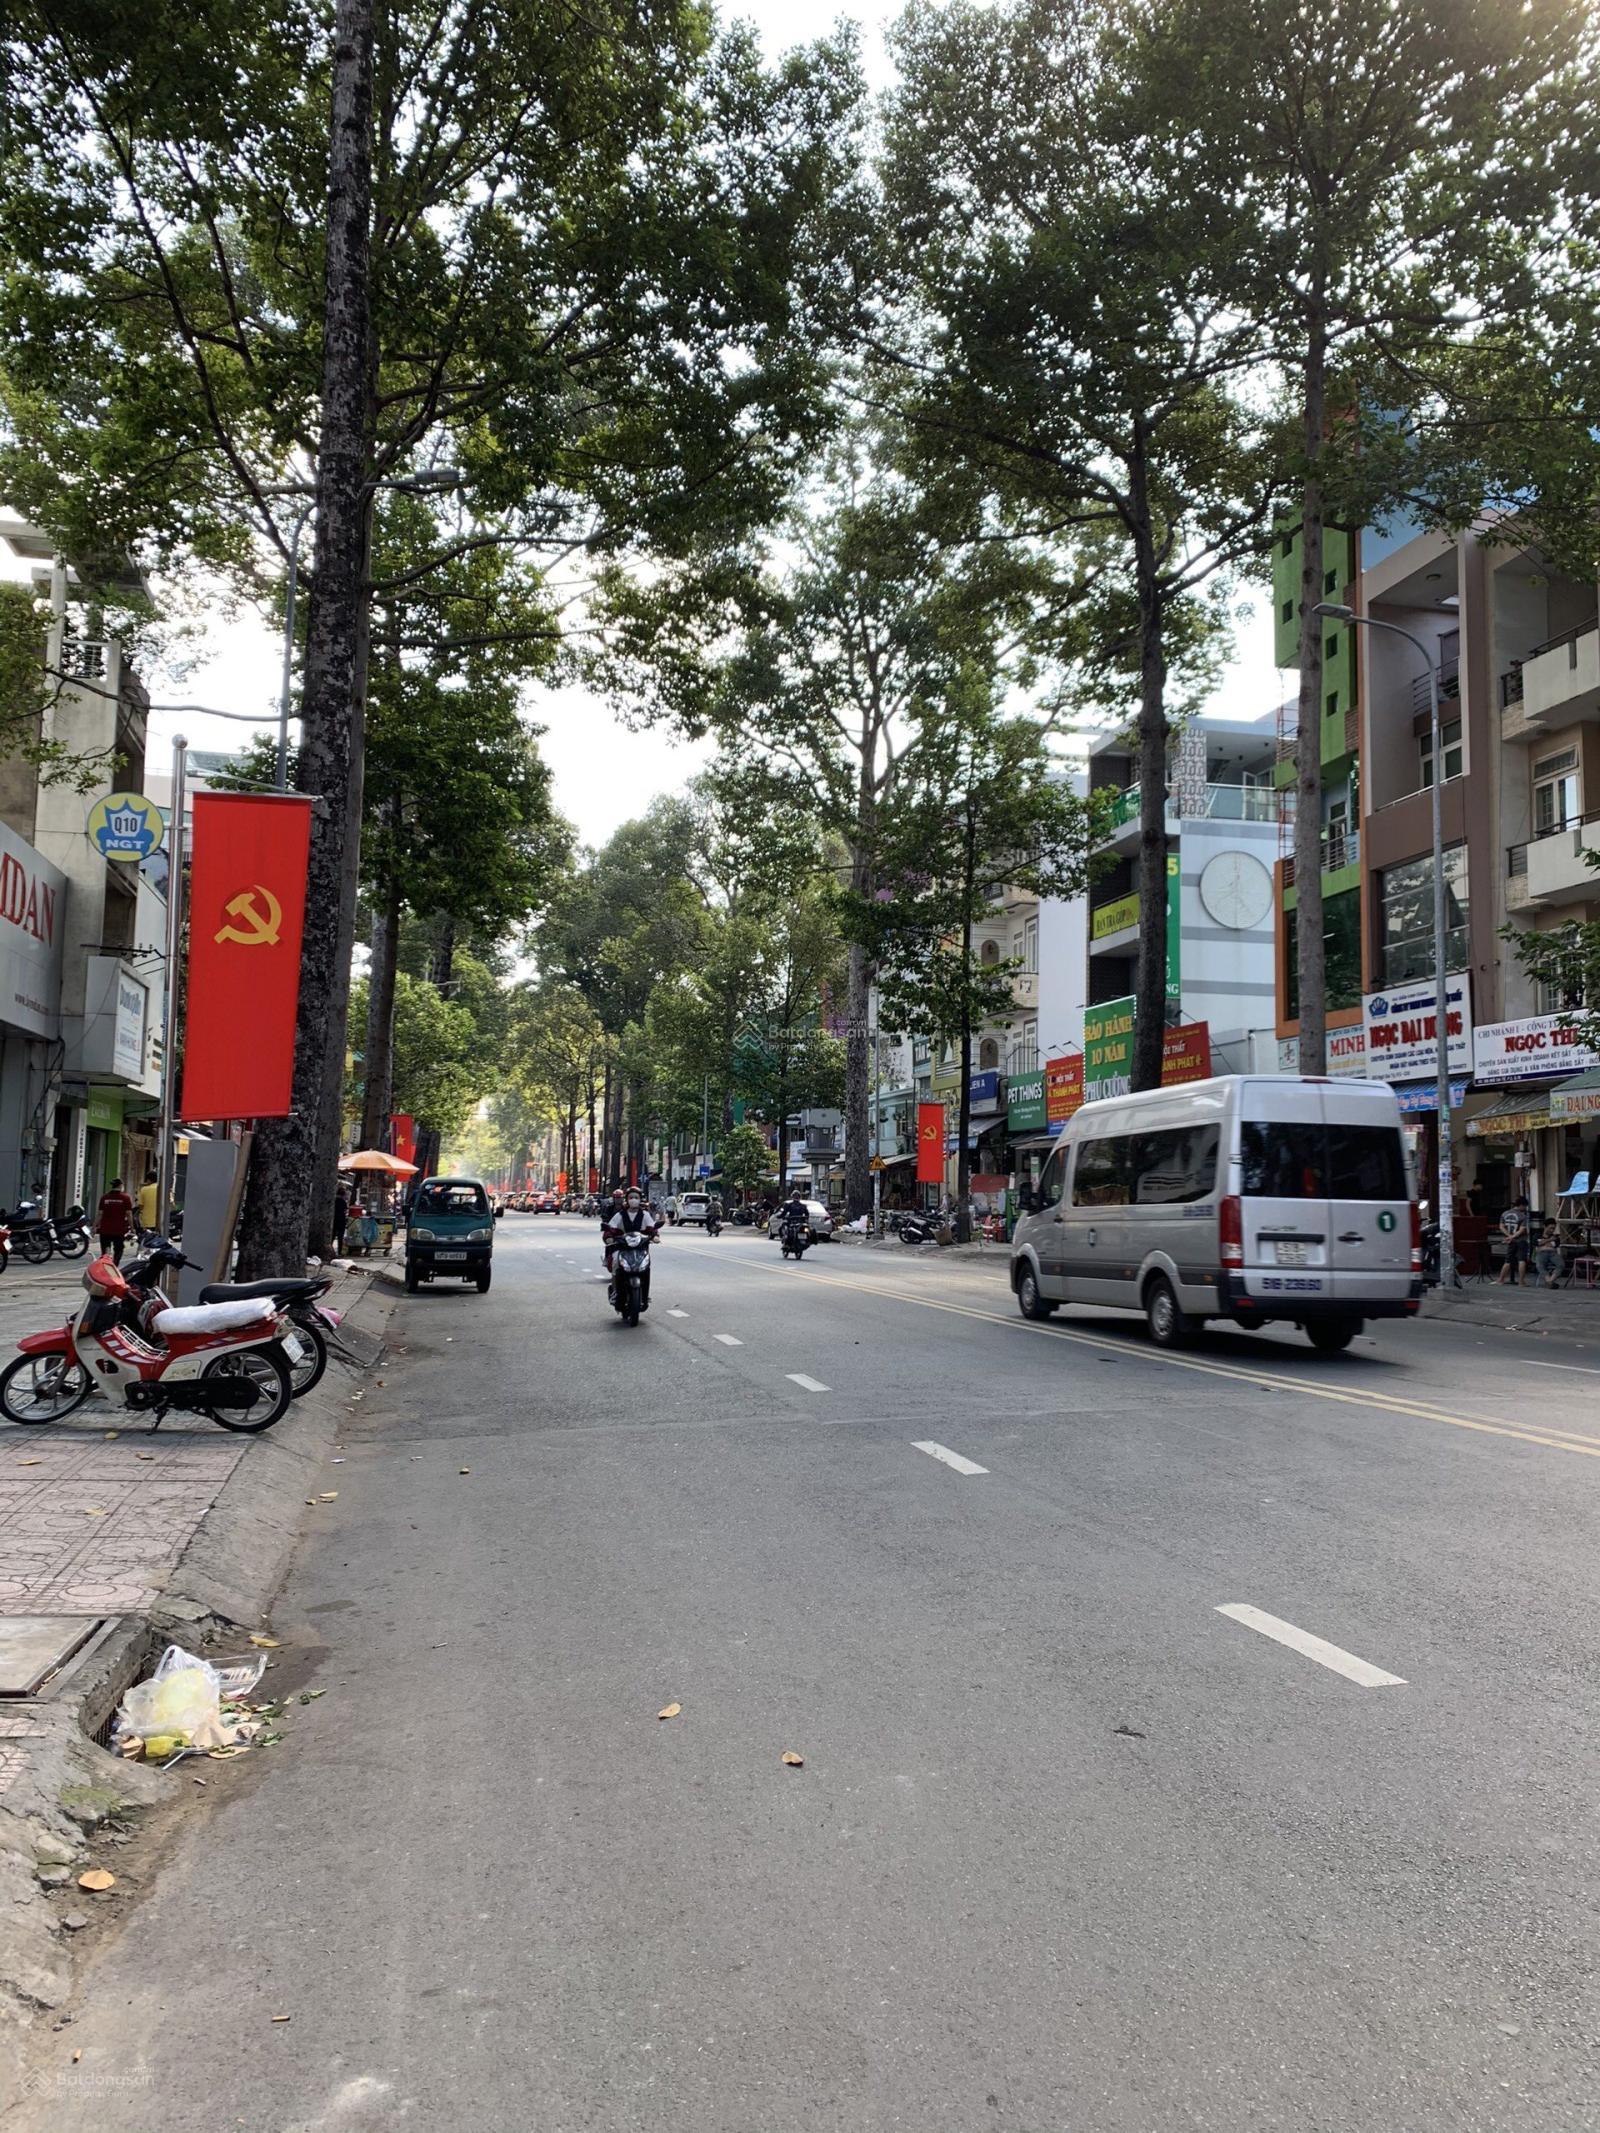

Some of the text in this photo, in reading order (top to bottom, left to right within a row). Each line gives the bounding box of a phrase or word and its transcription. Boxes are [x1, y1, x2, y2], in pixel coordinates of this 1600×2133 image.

[114, 815, 138, 834] Q10
[105, 838, 145, 849] NGT
[1526, 1020, 1547, 1033] CÔNG
[1330, 1034, 1365, 1058] MINH
[1504, 1032, 1547, 1053] NGỌC
[1008, 1081, 1043, 1104] PET THINGS
[1382, 1214, 1392, 1229] 1
